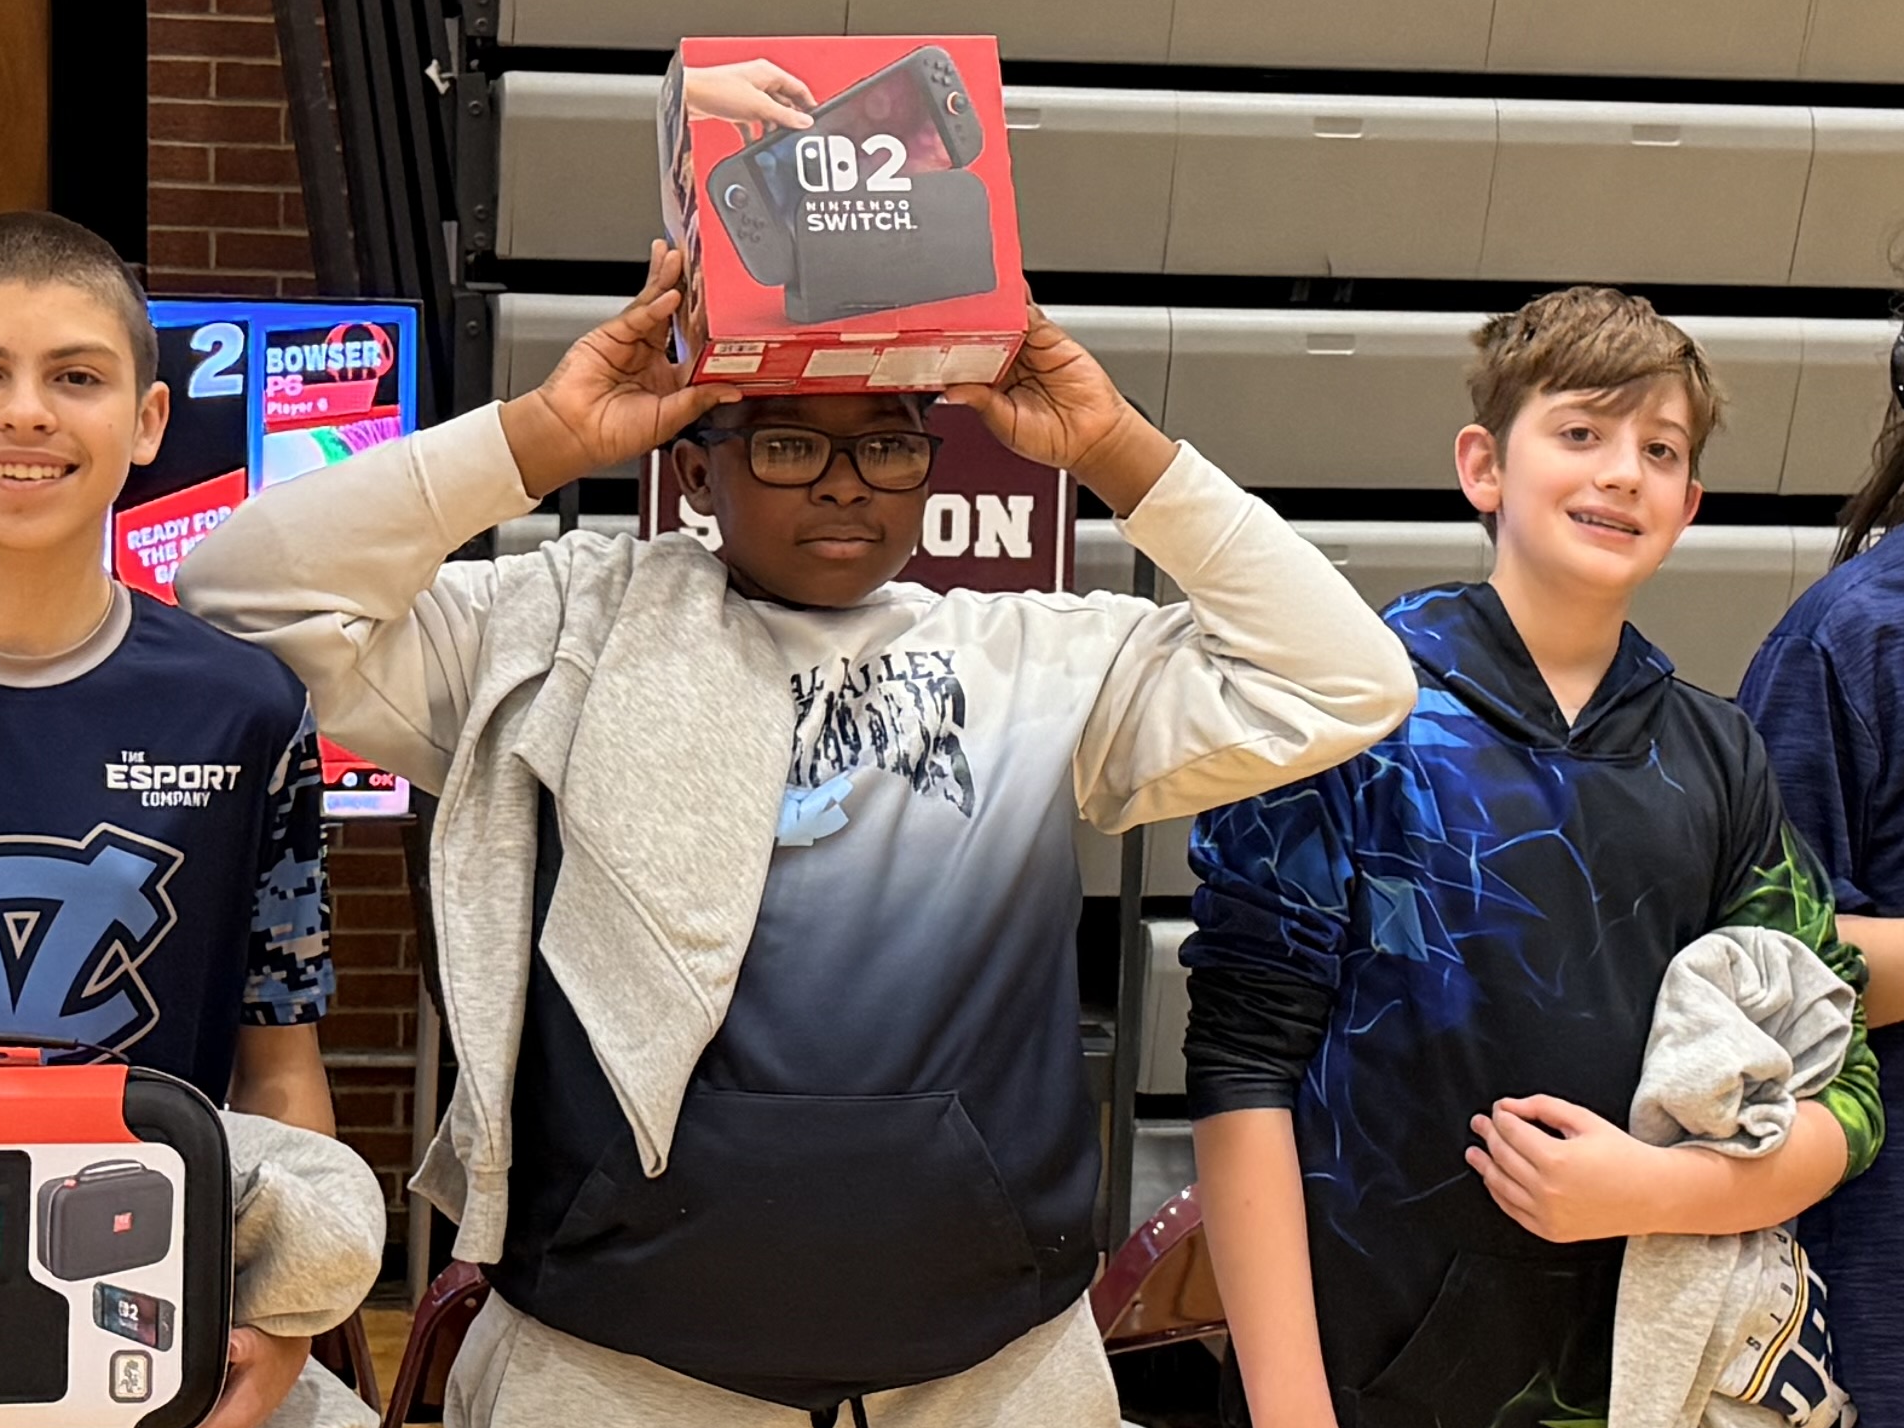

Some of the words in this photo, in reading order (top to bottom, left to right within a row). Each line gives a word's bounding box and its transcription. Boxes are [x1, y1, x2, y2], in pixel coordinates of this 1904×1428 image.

[805, 199, 910, 212] NINTENDO
[806, 212, 912, 232] SWITCH
[188, 322, 245, 399] 2
[265, 340, 382, 374] BOWSER
[266, 375, 304, 397] P6
[127, 516, 190, 550] READY
[138, 541, 179, 567] THE
[105, 763, 242, 790] ESPORT
[141, 791, 211, 808] COMPANY
